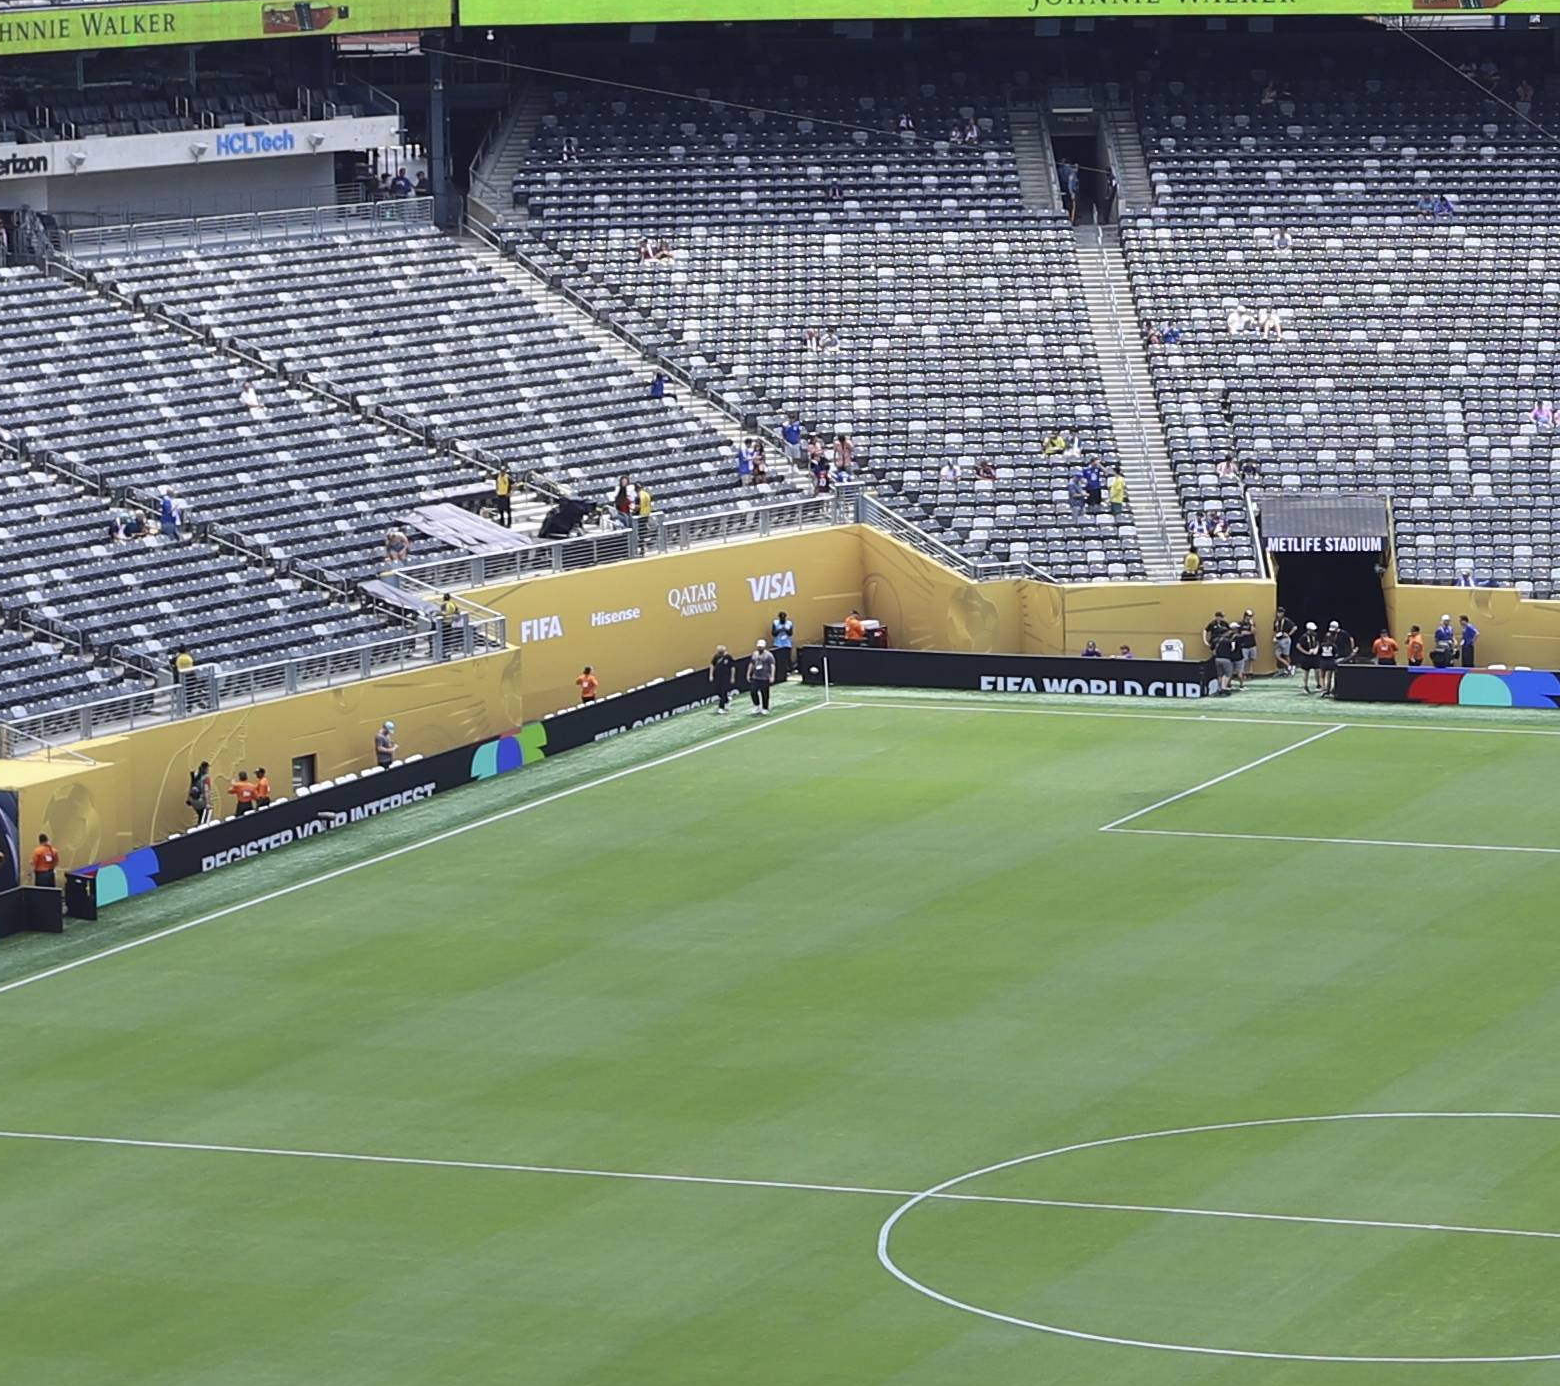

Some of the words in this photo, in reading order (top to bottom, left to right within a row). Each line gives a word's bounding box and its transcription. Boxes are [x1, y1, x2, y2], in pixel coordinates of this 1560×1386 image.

[80, 12, 175, 37] WALKER
[216, 129, 295, 156] HCLTech
[1267, 536, 1322, 552] METLIFE
[1325, 536, 1382, 552] STADIUM
[668, 582, 717, 610] QATAR
[746, 571, 796, 603] VISA
[591, 608, 641, 627] Hisense
[680, 600, 718, 619] AIRWAYS
[521, 615, 563, 644] FIFA
